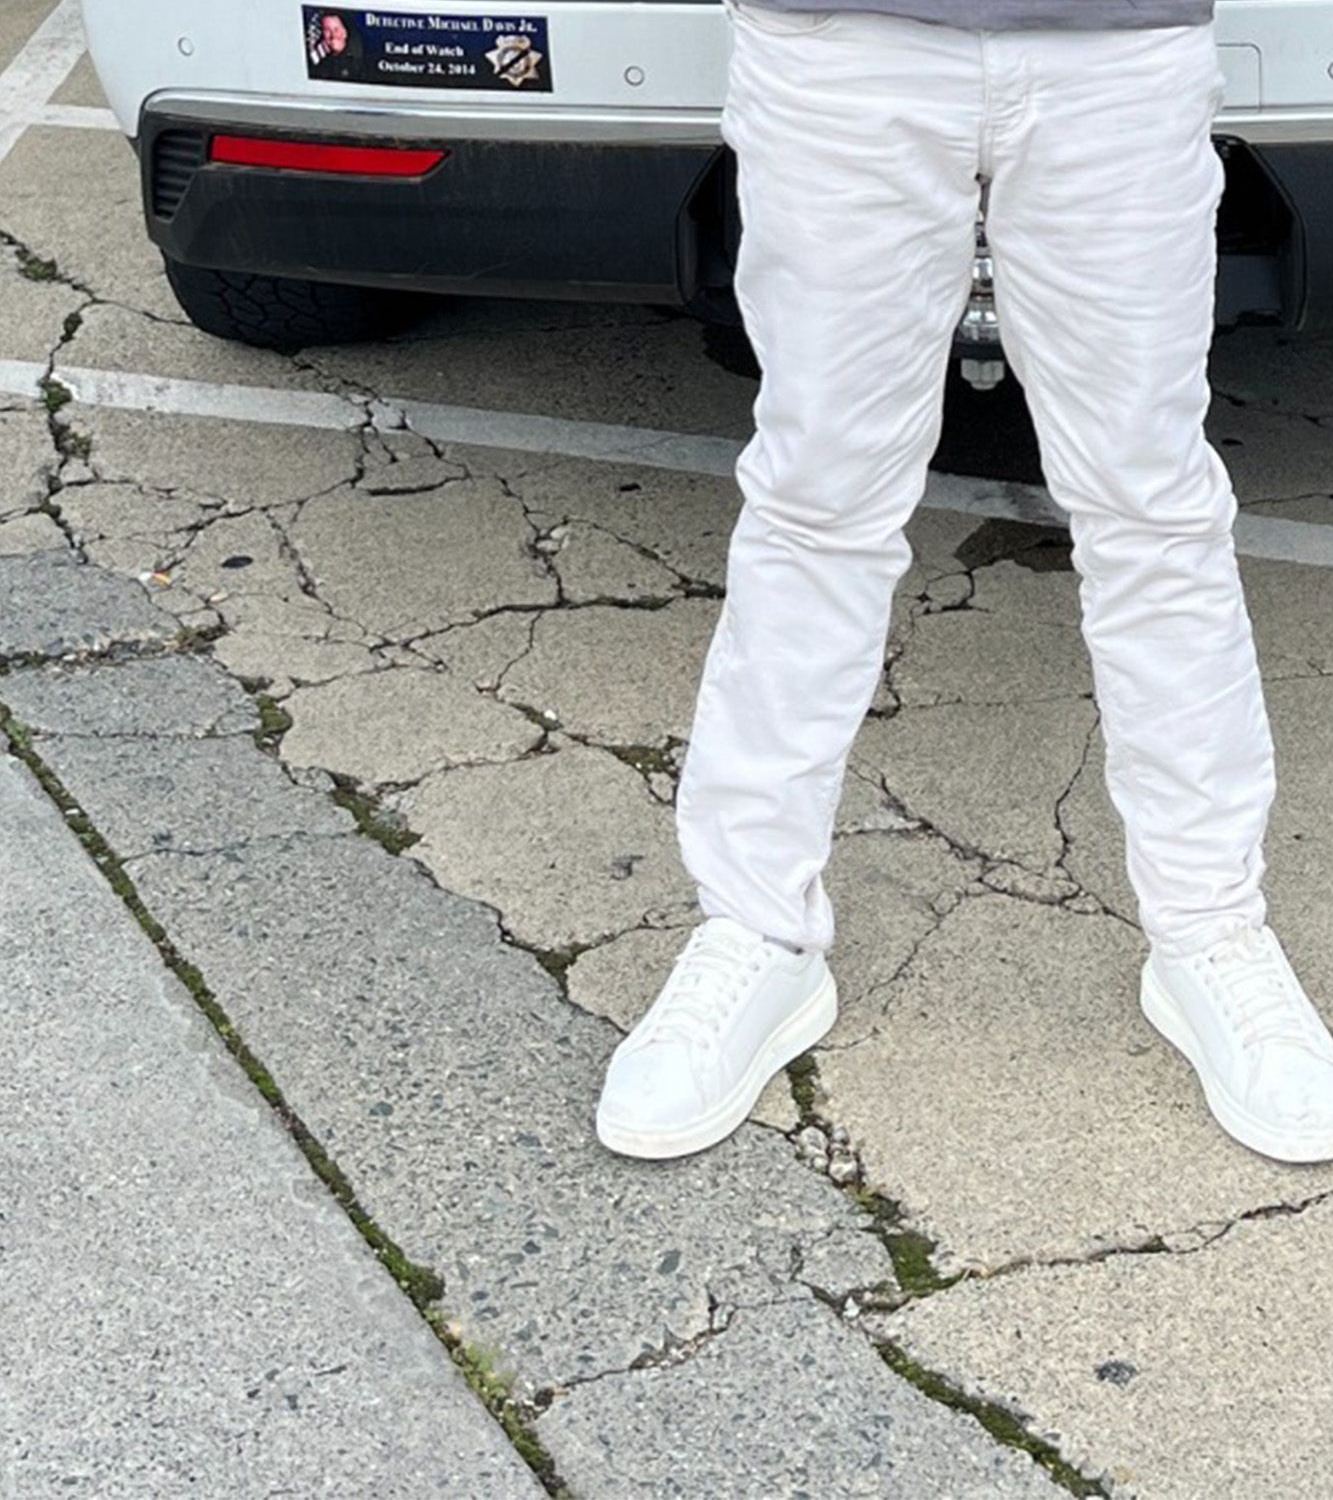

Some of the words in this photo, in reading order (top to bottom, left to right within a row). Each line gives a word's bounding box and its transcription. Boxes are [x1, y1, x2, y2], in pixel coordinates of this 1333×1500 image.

[385, 42, 408, 54] End
[412, 42, 424, 55] of
[426, 43, 464, 57] Watch
[378, 60, 424, 74] October
[449, 63, 476, 76] 2014
